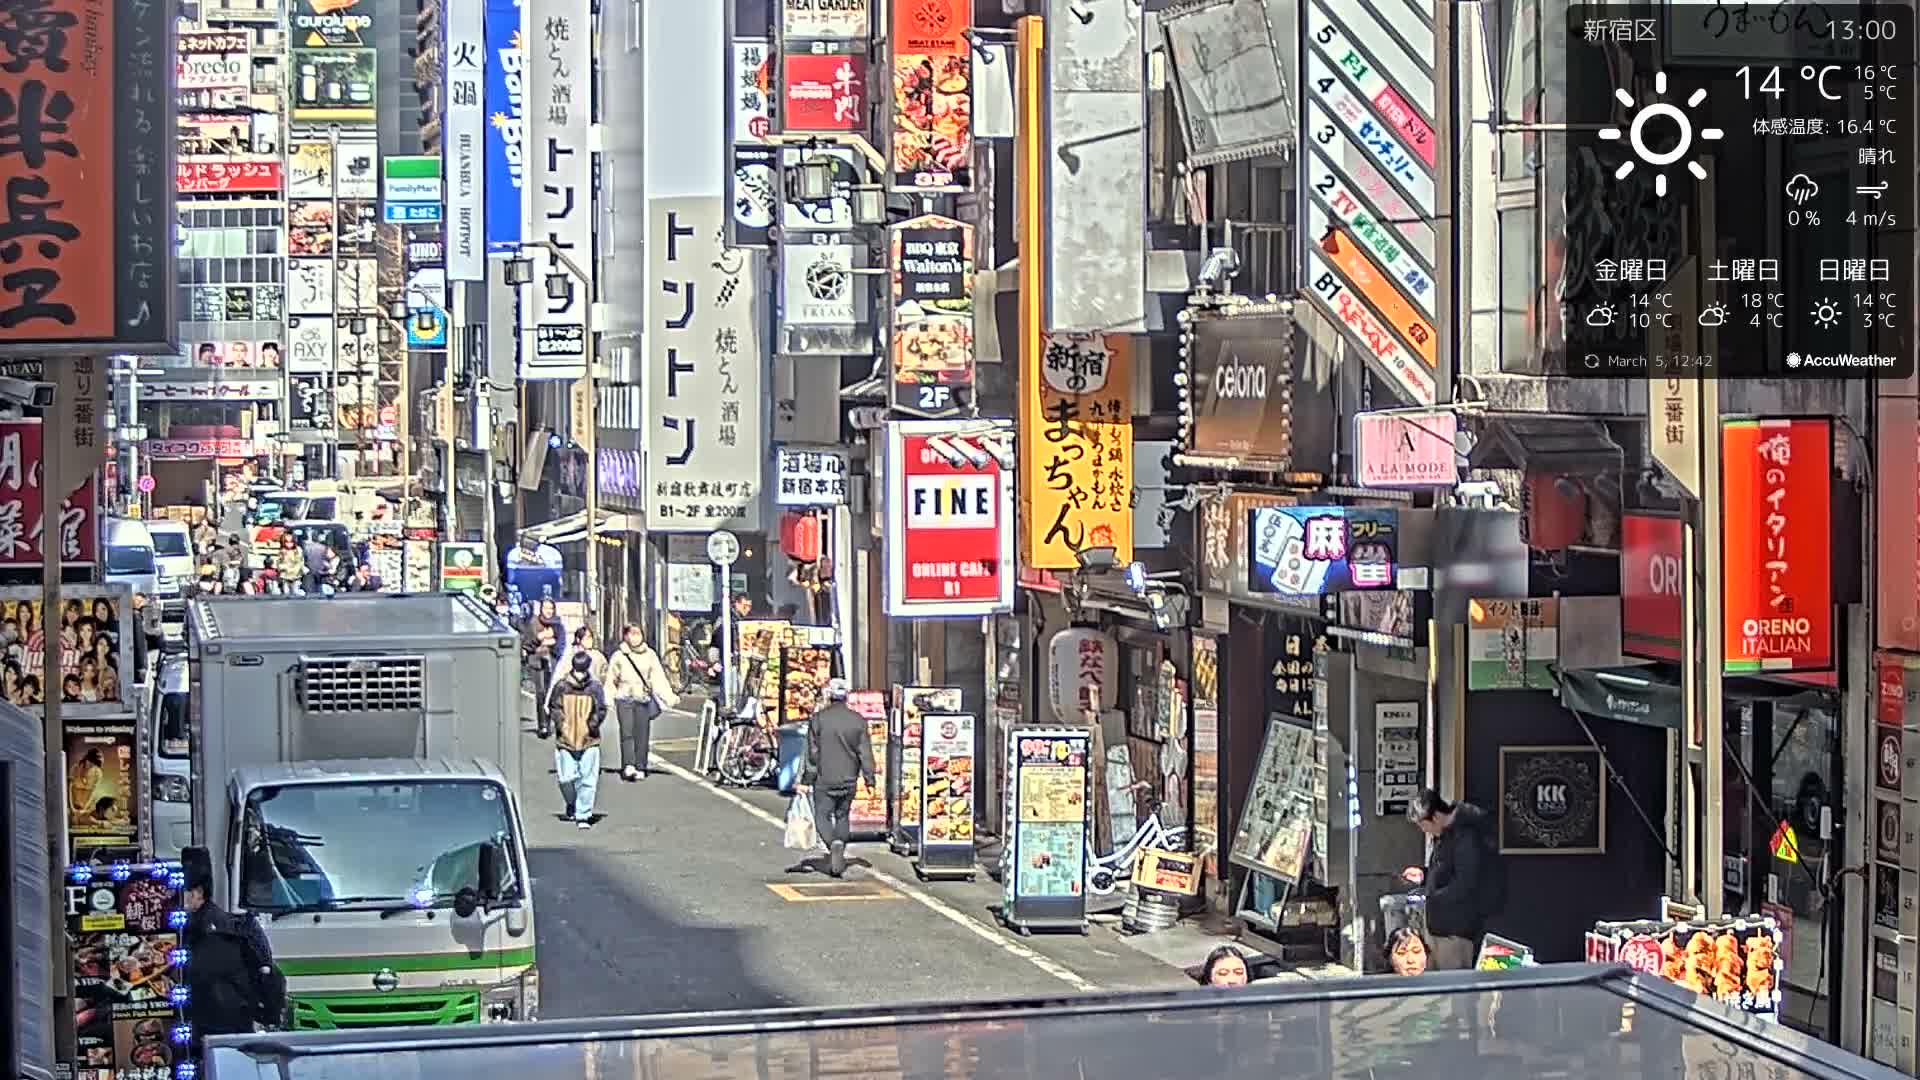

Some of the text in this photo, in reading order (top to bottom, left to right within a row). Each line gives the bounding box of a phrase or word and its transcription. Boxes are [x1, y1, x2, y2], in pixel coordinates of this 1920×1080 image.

[1317, 24, 1337, 45] 5
[452, 41, 478, 107] 火鍋
[545, 16, 572, 127] 焼とん酒場
[1317, 76, 1336, 94] 4
[1317, 125, 1337, 145] 3
[1359, 120, 1416, 183] センチュリー
[1316, 174, 1336, 196] 2
[543, 137, 574, 317] トントン
[903, 258, 962, 274] Walton's
[1314, 272, 1342, 301] B1
[661, 212, 695, 466] トントン
[1046, 342, 1106, 378] 新宿
[715, 326, 740, 448] 焼とん酒場
[1066, 375, 1087, 392] の
[1215, 357, 1267, 399] celona
[918, 386, 950, 408] 2F
[1043, 398, 1089, 553] まっちゃん
[1404, 462, 1449, 474] MODE
[782, 478, 846, 495] 新宿本店
[913, 487, 989, 515] FINE
[1351, 521, 1392, 538] フリー
[1757, 432, 1793, 608] 俺のイタリアン
[912, 562, 957, 578] ONLINE
[1742, 618, 1811, 637] ORENO
[1742, 638, 1812, 656] ITALIAN
[1536, 784, 1567, 803] KK
